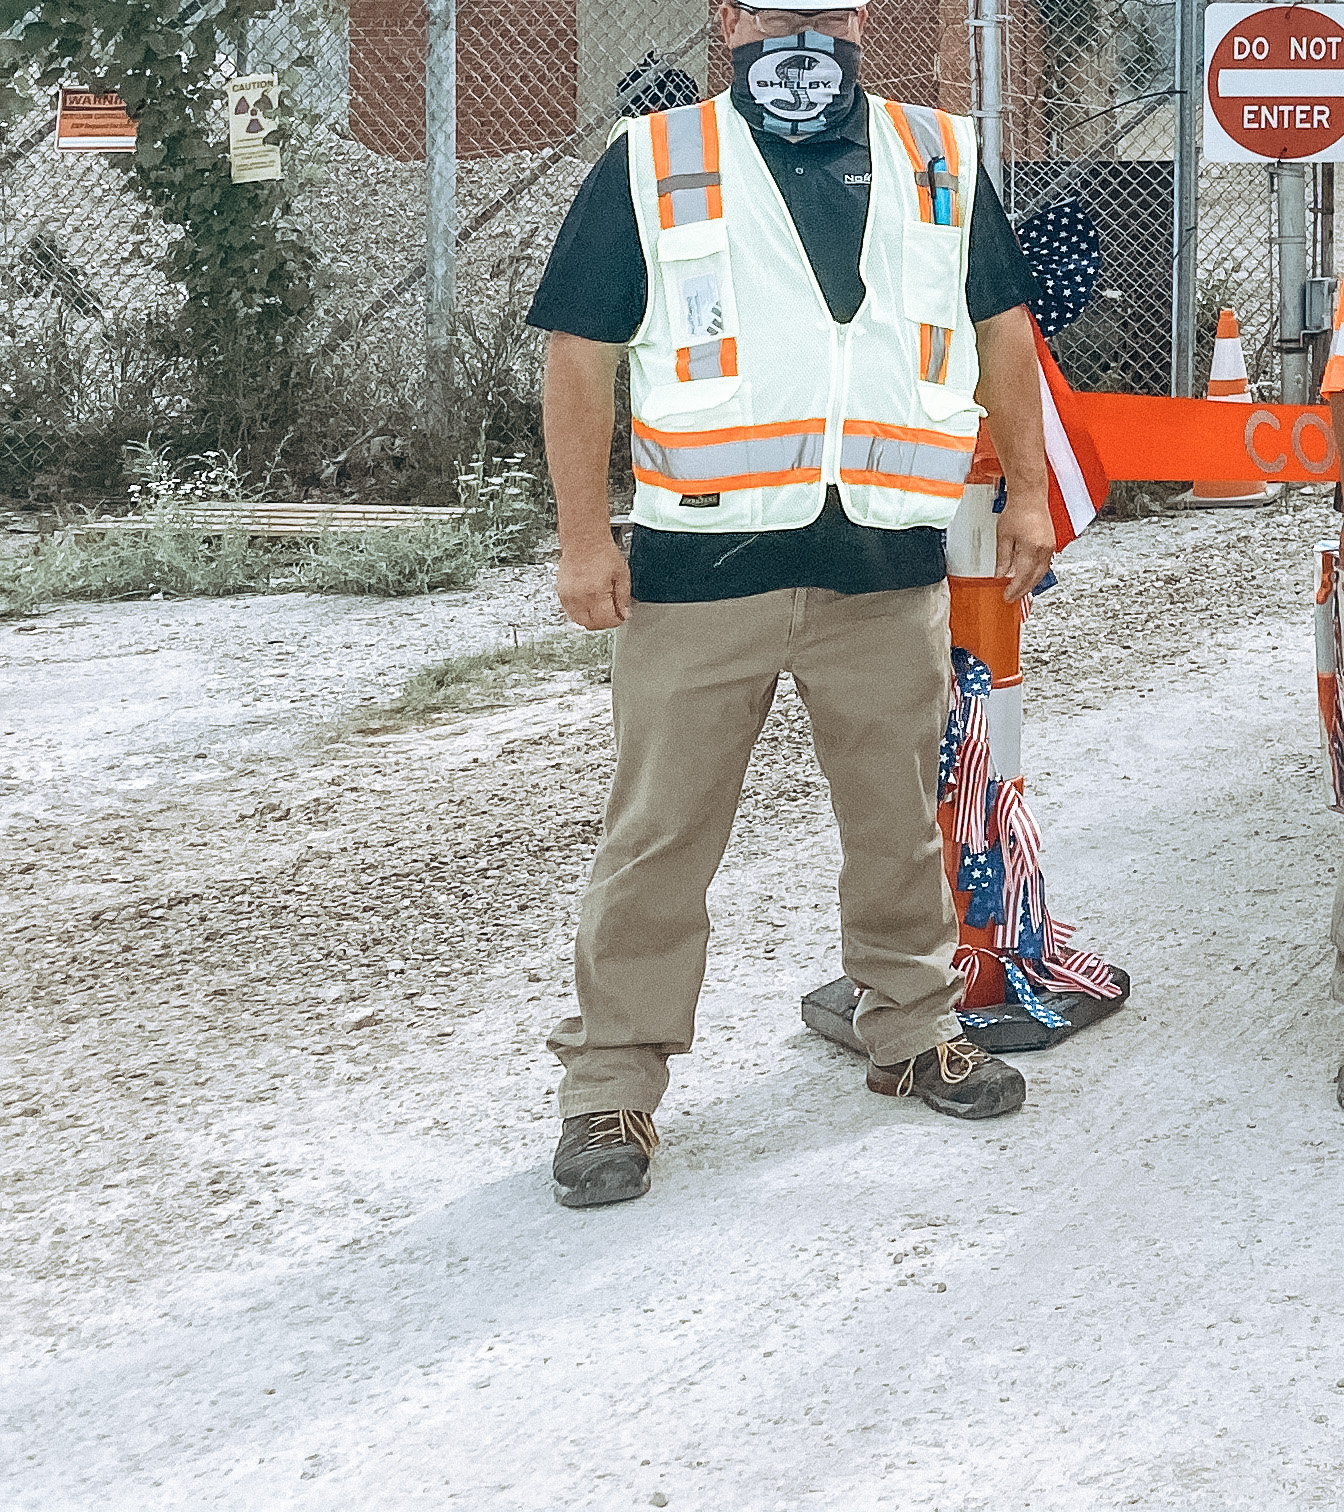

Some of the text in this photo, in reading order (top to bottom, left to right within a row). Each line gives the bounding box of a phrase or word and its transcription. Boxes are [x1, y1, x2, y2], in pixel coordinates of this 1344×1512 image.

[1233, 36, 1343, 61] DO NOT
[232, 80, 274, 93] CAUTION
[756, 80, 832, 90] SHELBY
[68, 94, 124, 105] WARNI
[1243, 105, 1331, 129] ENTER
[1244, 409, 1337, 475] CO
